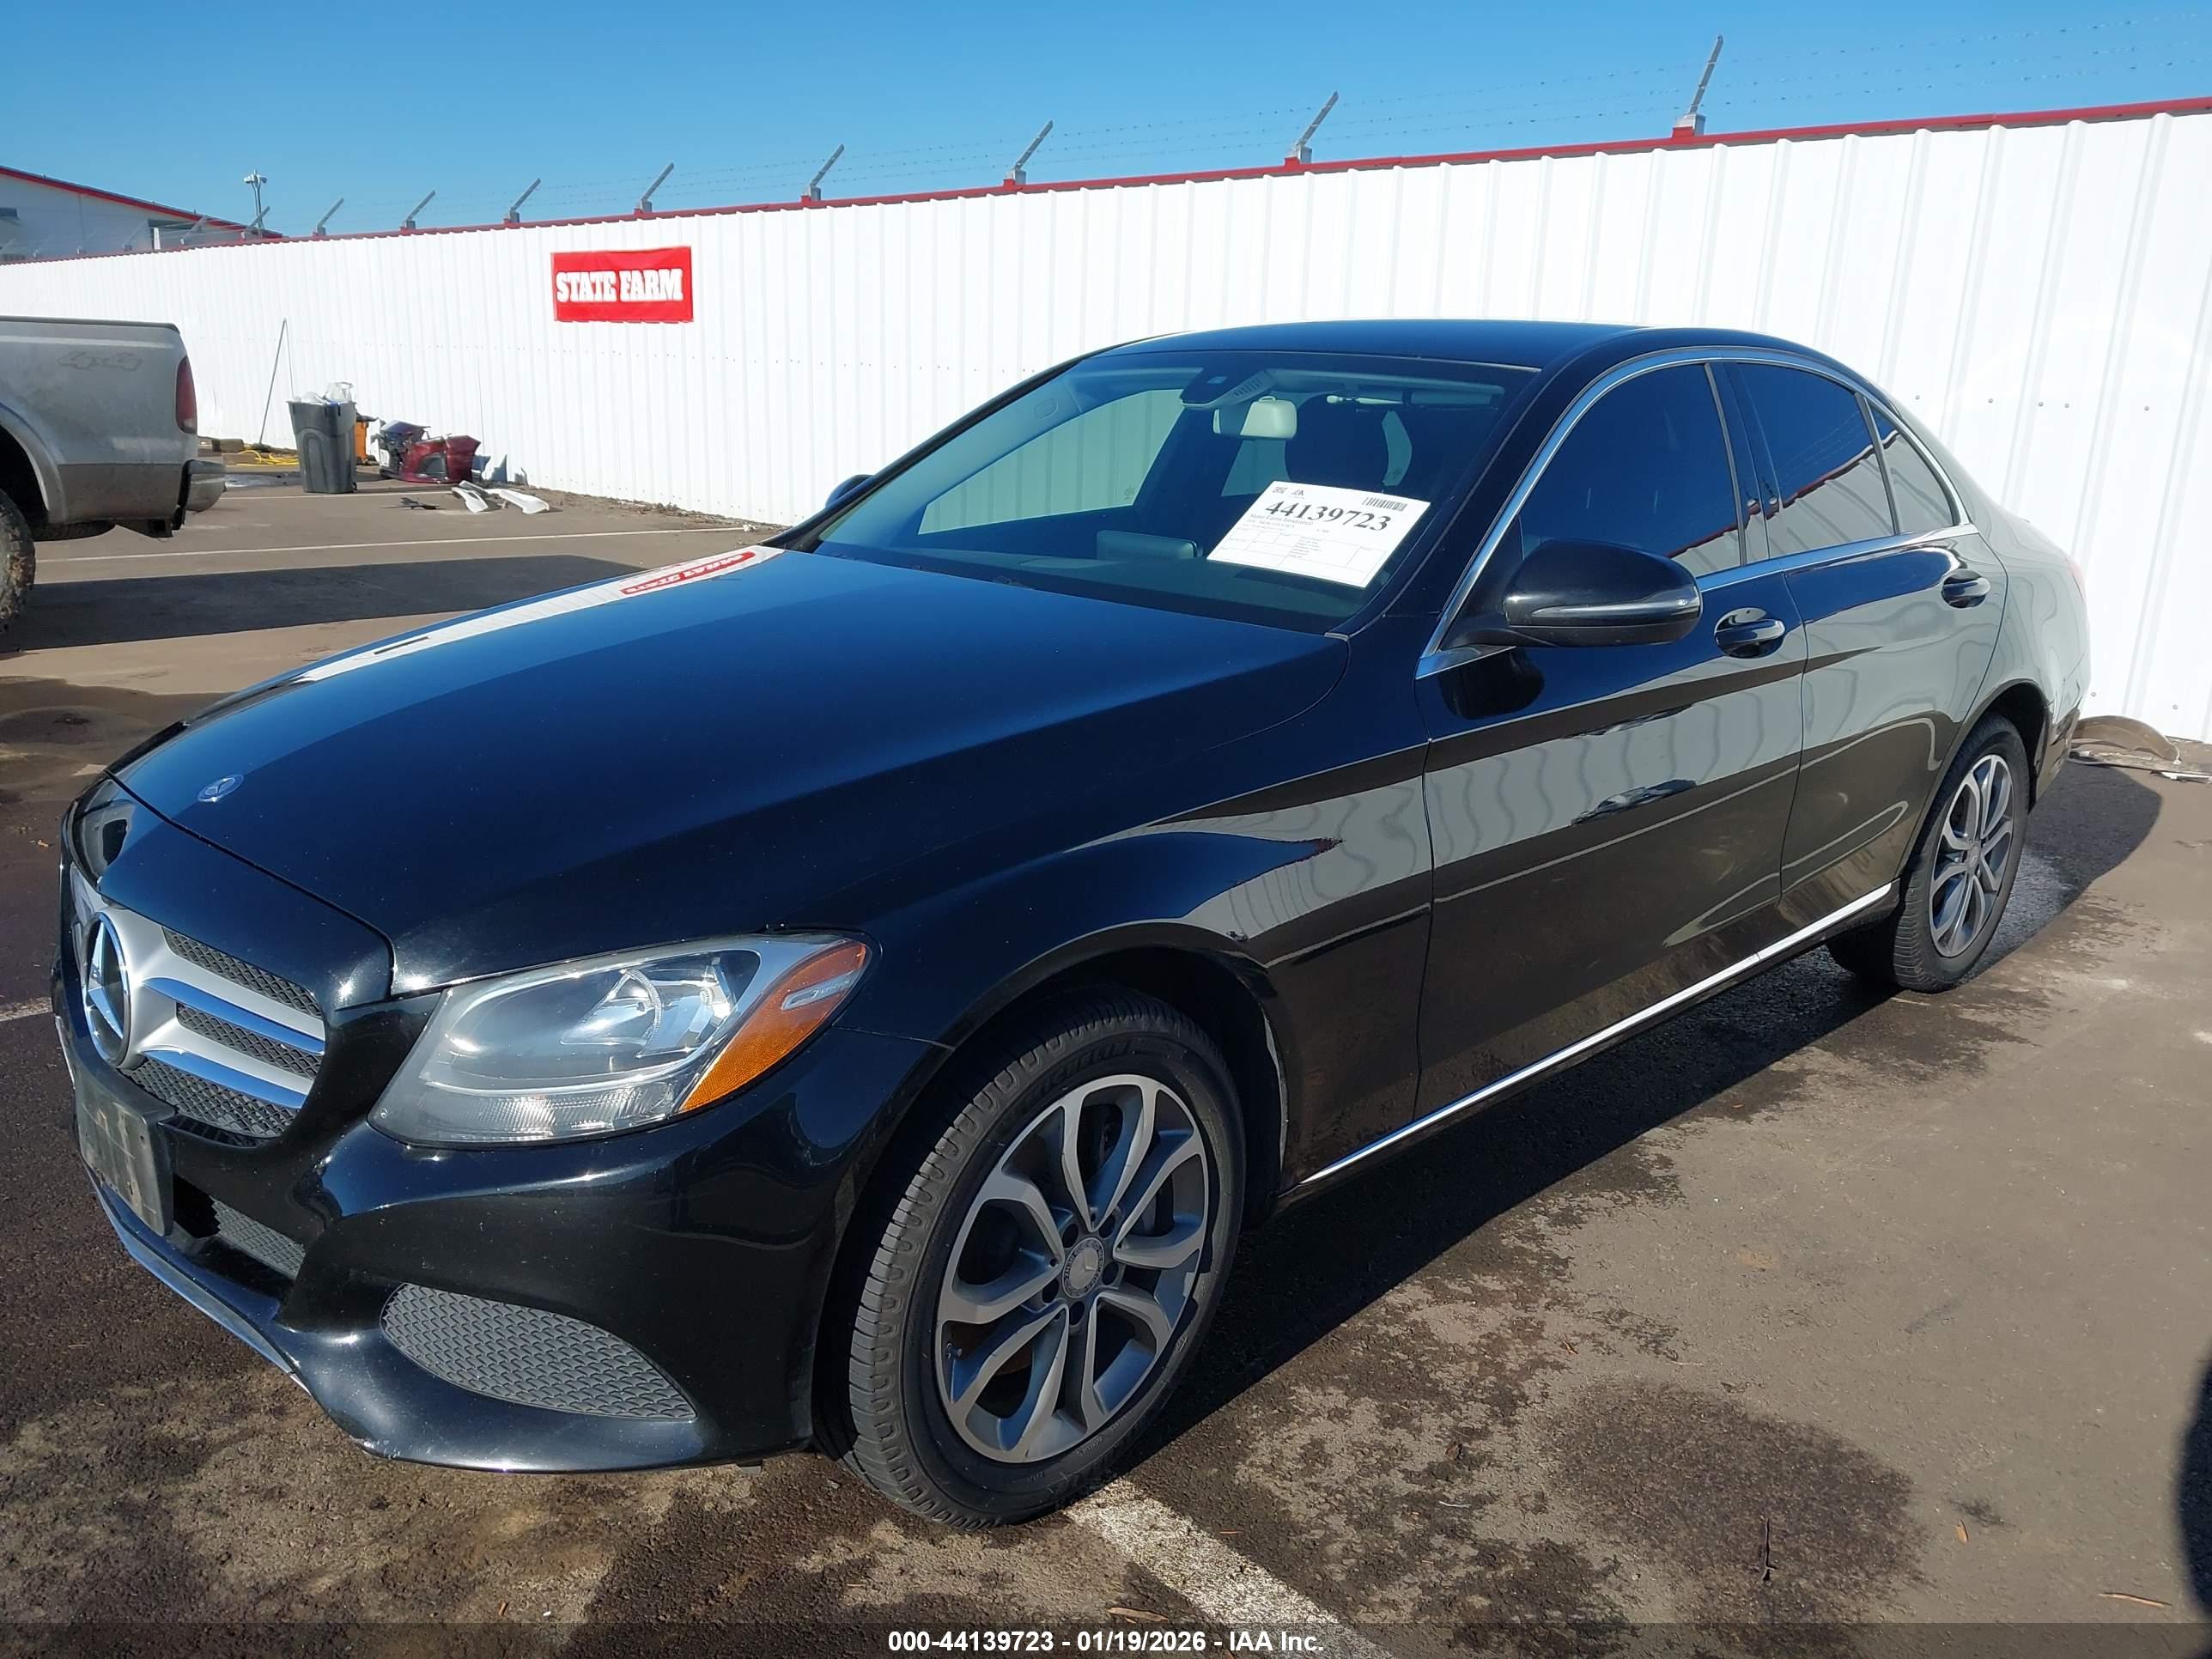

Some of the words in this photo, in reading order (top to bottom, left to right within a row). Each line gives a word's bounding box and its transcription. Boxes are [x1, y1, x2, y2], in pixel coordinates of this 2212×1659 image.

[556, 270, 617, 303] STATE
[618, 268, 684, 302] FARM
[1265, 501, 1391, 532] 44139723
